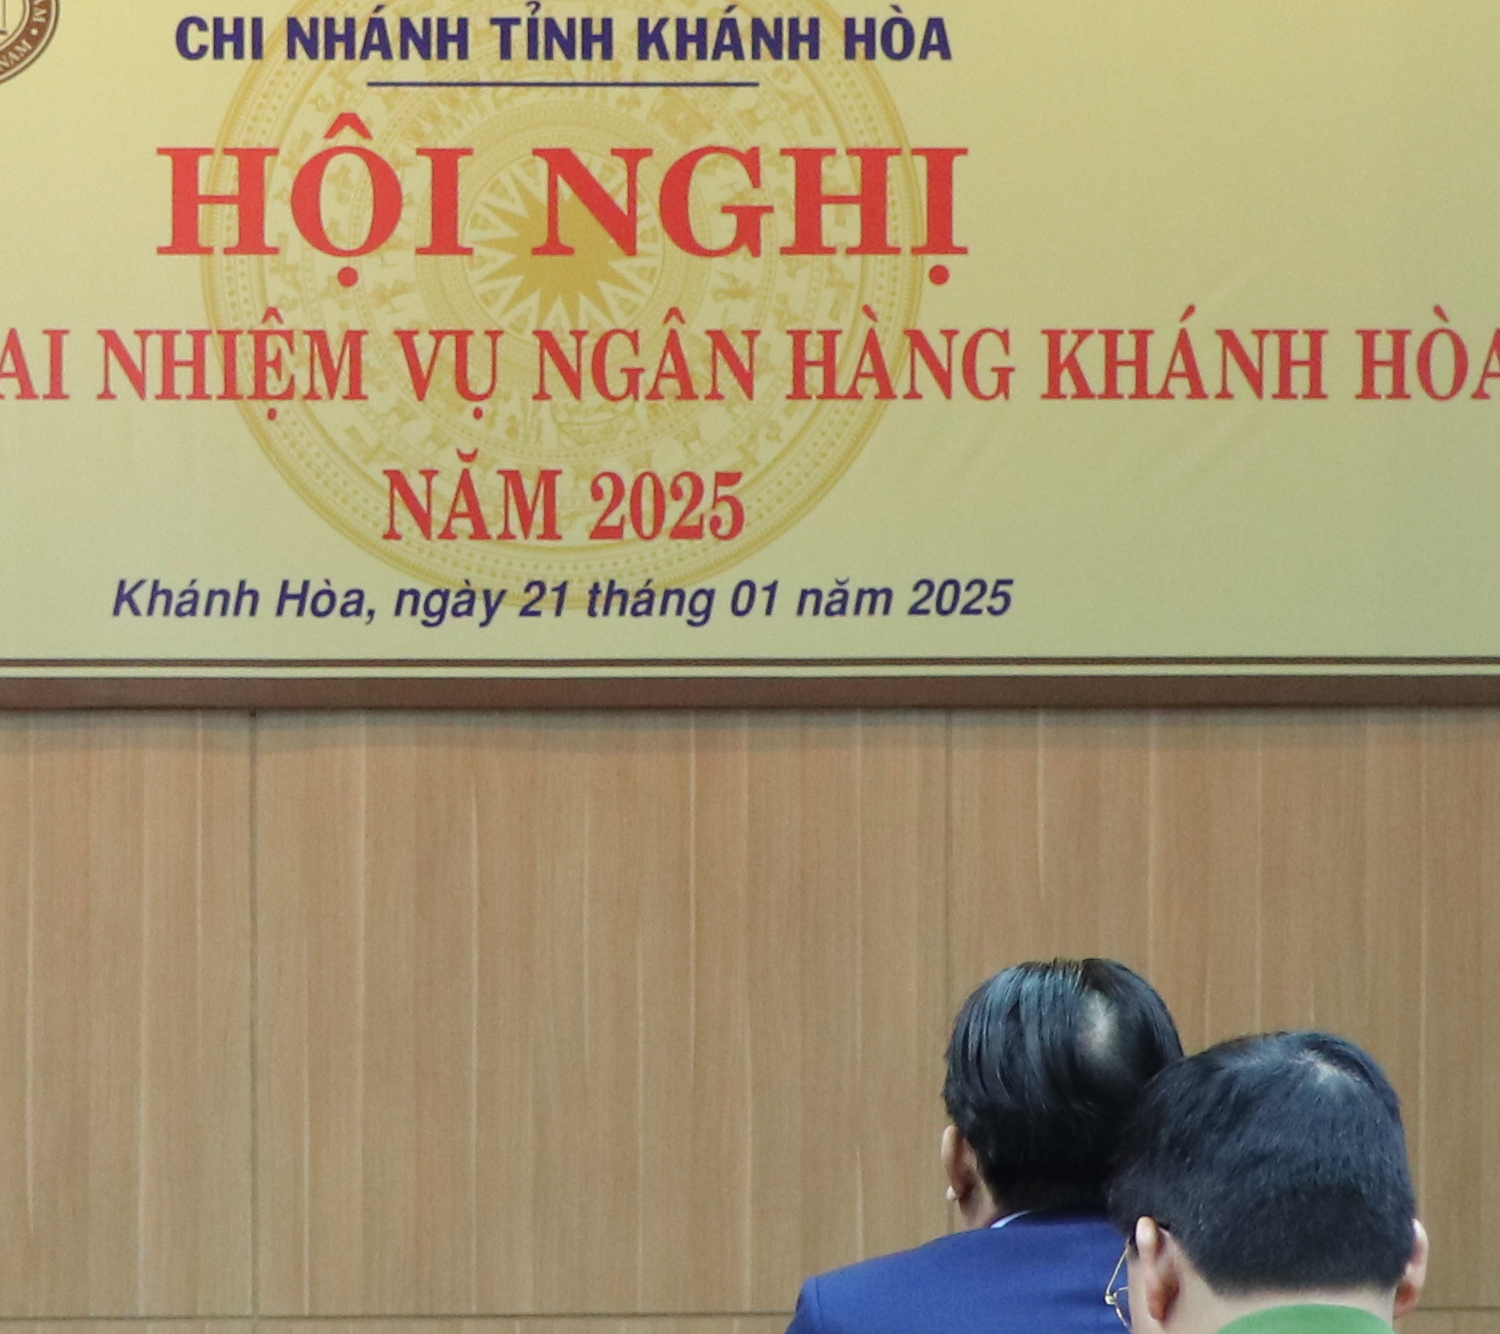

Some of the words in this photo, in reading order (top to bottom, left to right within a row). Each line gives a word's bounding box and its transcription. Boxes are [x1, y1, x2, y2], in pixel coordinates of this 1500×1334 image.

[176, 16, 264, 60] CHI
[288, 3, 469, 60] NHÁNH
[491, 0, 614, 60] TỈNH
[638, 4, 820, 60] KHÁNH
[845, 4, 952, 60] HÒA
[157, 112, 474, 288] HỘI
[531, 145, 969, 286] NGHỊ
[97, 306, 369, 421] NHIỆM
[393, 329, 504, 420] VỤ
[532, 306, 761, 402] NGÂN
[786, 305, 1016, 401] HÀNG
[1041, 305, 1328, 401] KHÁNH
[382, 448, 562, 541] NĂM
[589, 471, 745, 541] 2025
[113, 578, 260, 617] Khánh
[276, 579, 376, 625] Hòa,
[395, 581, 506, 627] ngày
[519, 580, 568, 617] 21
[588, 579, 715, 627] tháng
[731, 579, 778, 617] 01
[796, 579, 893, 617] năm
[908, 578, 1014, 616] 2025
